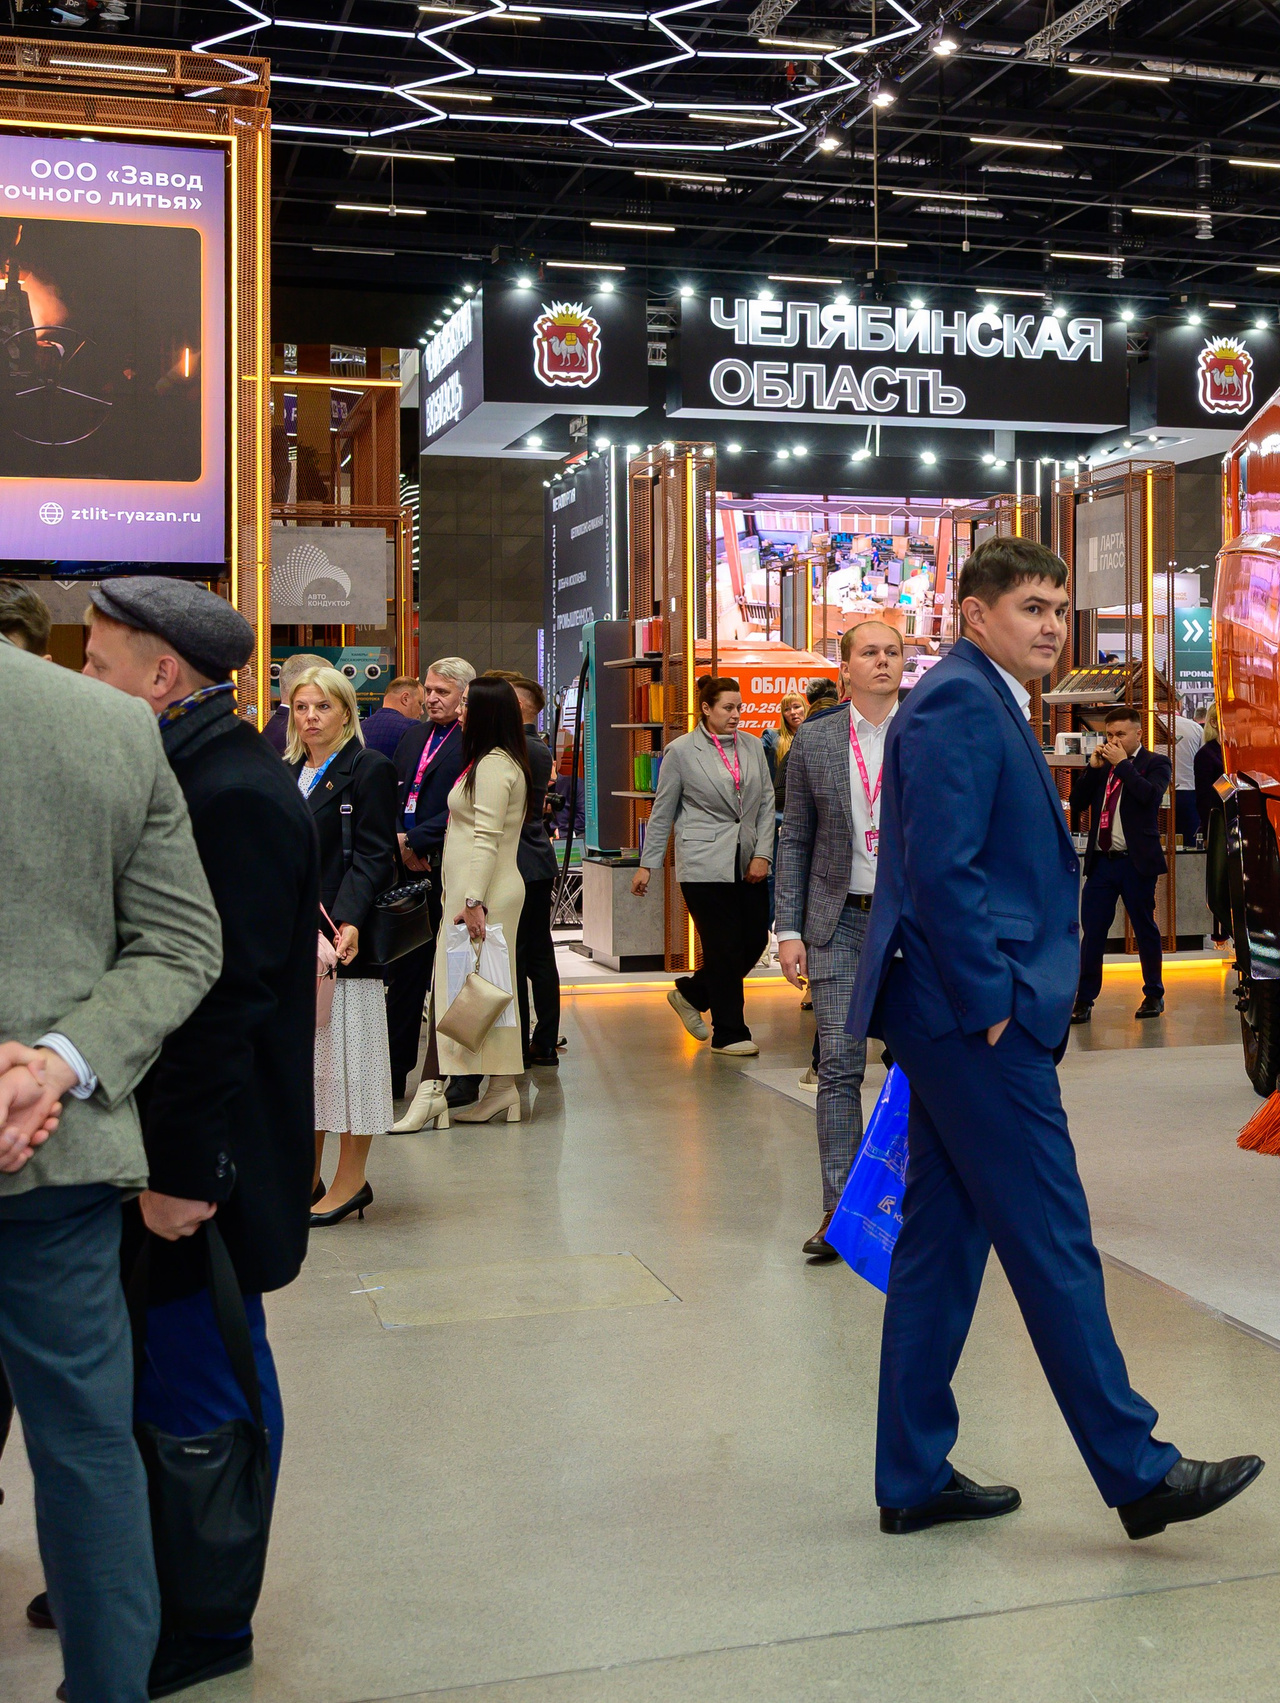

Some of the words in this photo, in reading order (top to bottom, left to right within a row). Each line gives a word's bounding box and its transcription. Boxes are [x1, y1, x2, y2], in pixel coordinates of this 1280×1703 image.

[30, 158, 98, 182] ООО
[106, 165, 204, 192] «Завод
[0, 184, 102, 204] очного
[109, 191, 203, 211] литья»
[710, 297, 1102, 363] ЧЕЛЯБИНСКАЯ
[709, 357, 966, 415] ОБЛАСТЬ
[71, 506, 201, 524] ztlit-ryazan.ru
[1100, 532, 1125, 551] ЛАРТА
[1100, 551, 1125, 571] ГЛАСС
[751, 676, 812, 695] ОБЛАС
